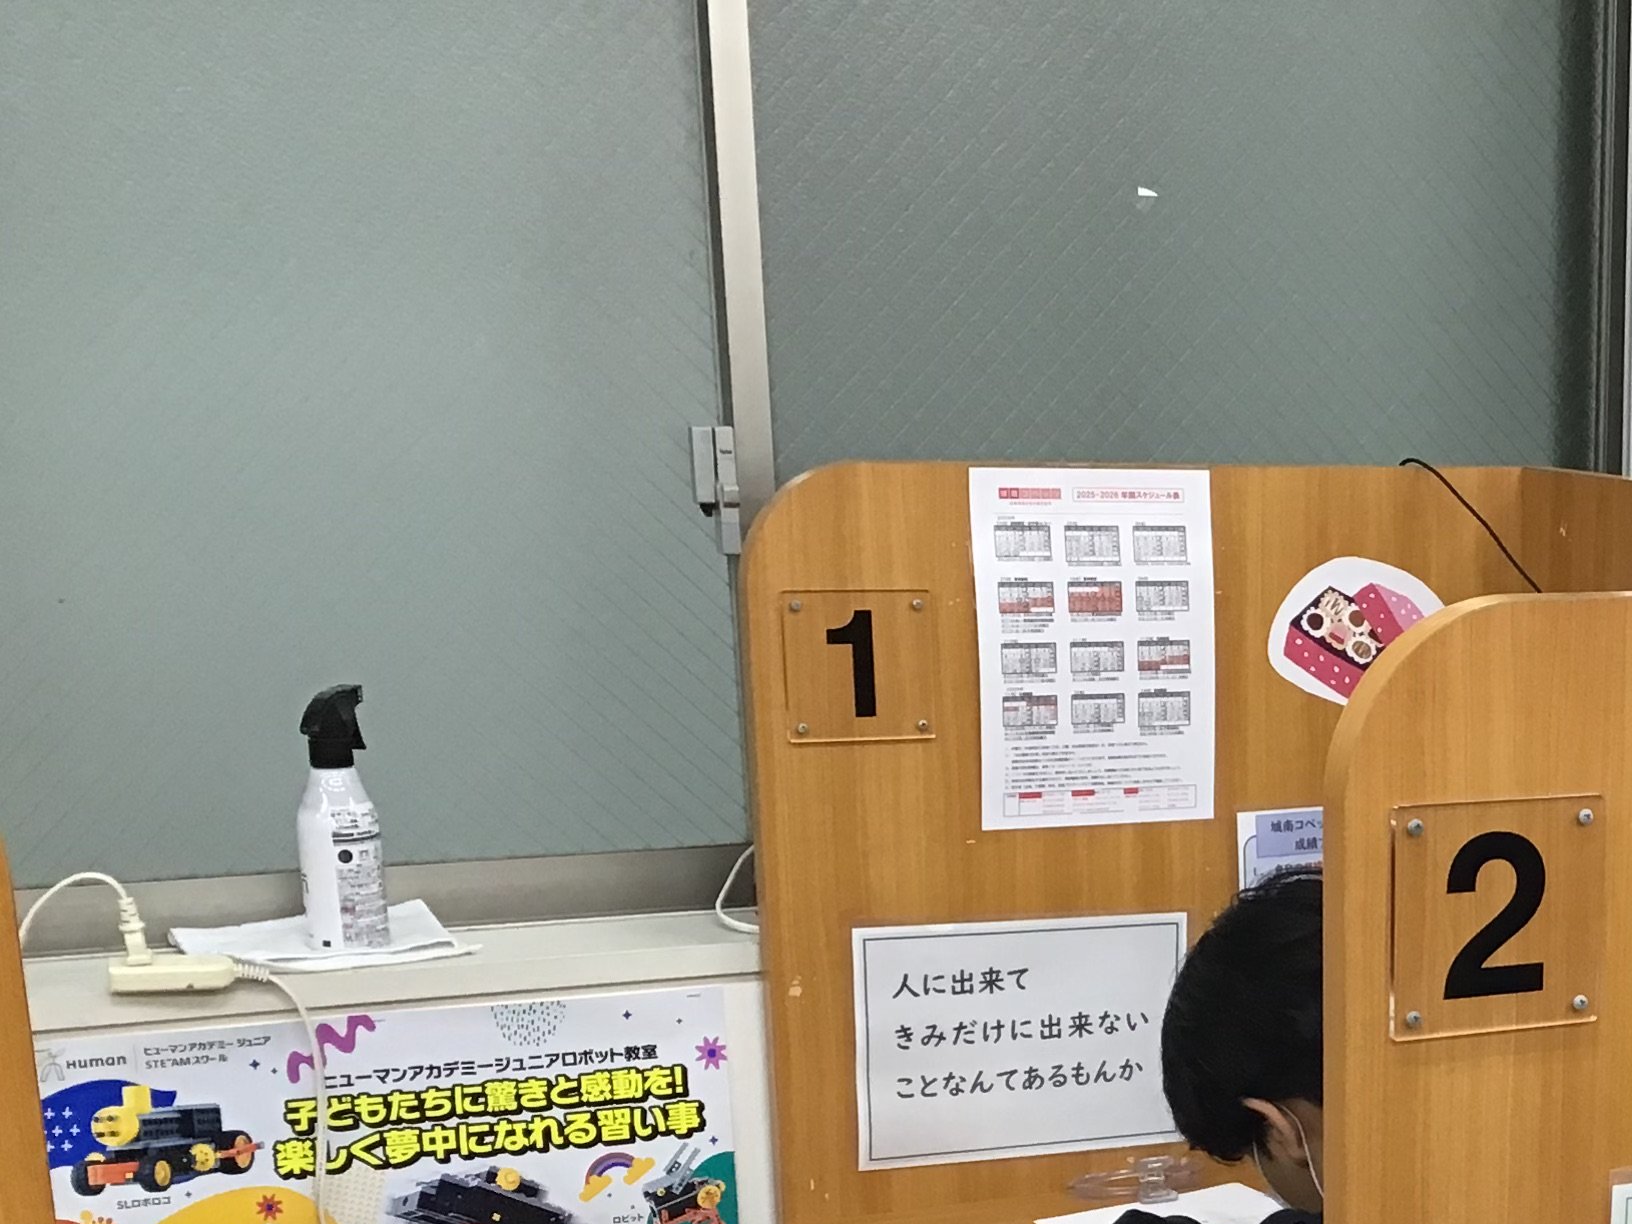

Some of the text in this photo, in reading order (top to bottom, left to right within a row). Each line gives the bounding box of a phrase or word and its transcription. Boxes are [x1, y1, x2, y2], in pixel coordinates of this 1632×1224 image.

[826, 609, 877, 718] 1
[1442, 830, 1546, 1001] 2
[891, 967, 1029, 999] 人に出来て
[894, 1010, 1149, 1050] きみだけに出来ない
[896, 1058, 1143, 1099] ことなんてあるもんか
[274, 1101, 702, 1178] 楽しく夢中になれる習い事
